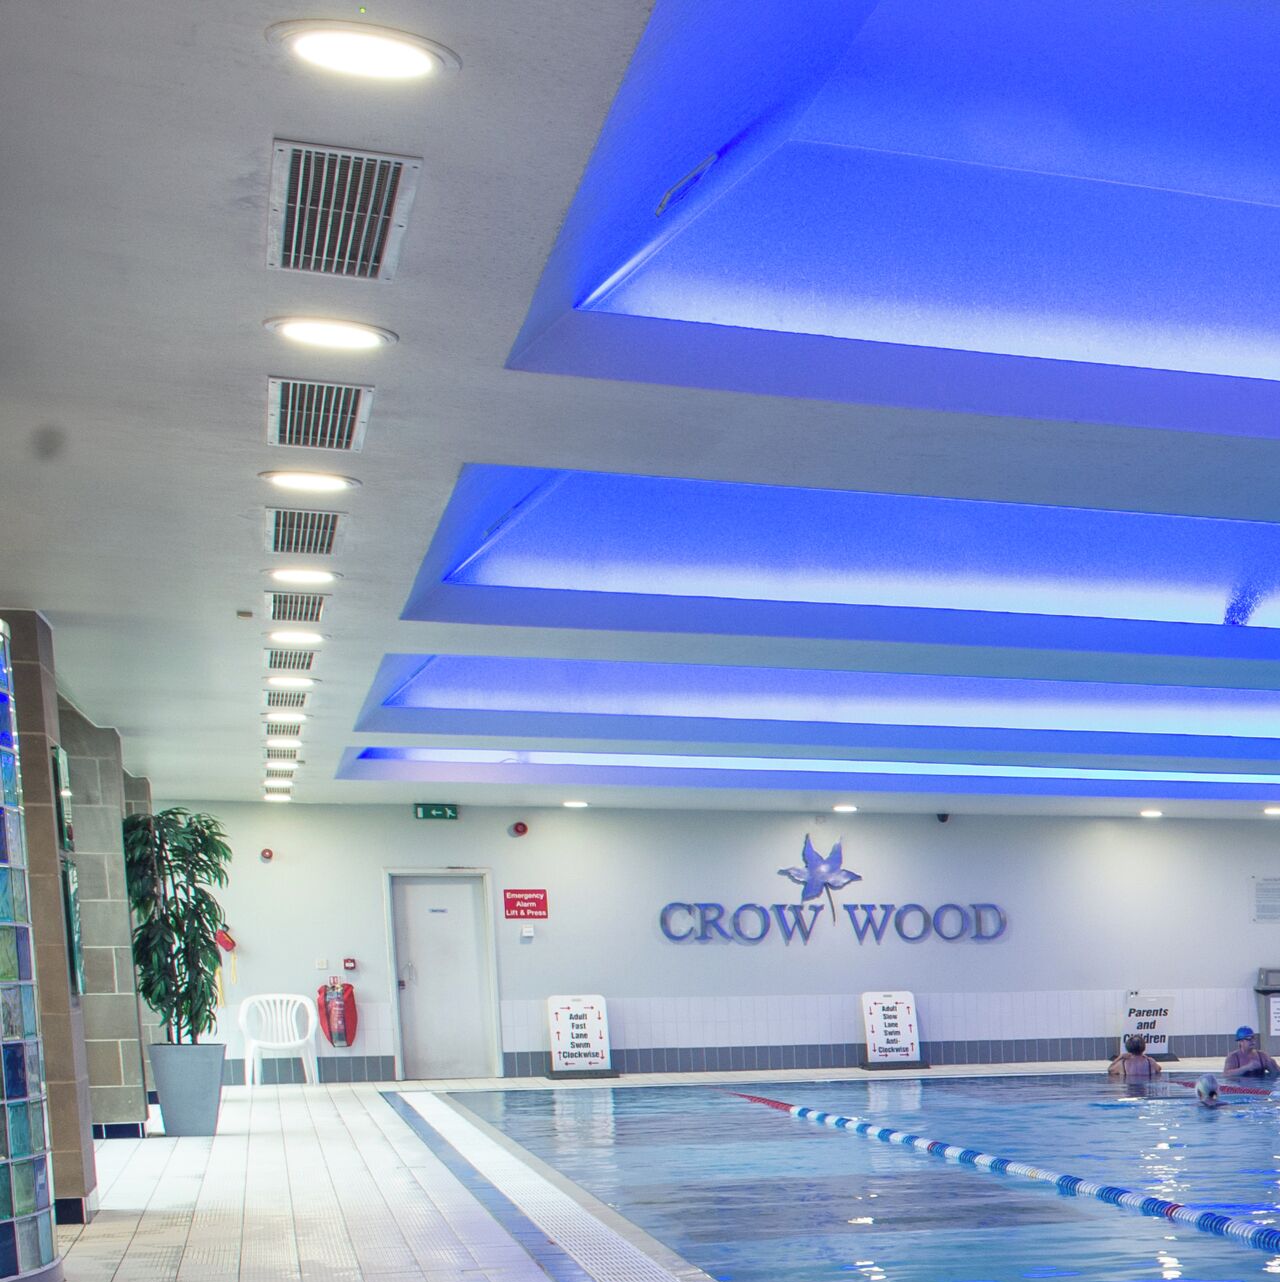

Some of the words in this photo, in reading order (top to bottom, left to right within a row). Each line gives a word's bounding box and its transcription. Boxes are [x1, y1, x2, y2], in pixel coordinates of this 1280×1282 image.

[506, 892, 544, 900] Emergency
[659, 902, 825, 945] CROW
[843, 903, 1008, 945] WOOD
[1128, 1008, 1168, 1017] Parents
[1136, 1020, 1156, 1030] and
[1123, 1033, 1166, 1043] Cdren
[562, 1051, 600, 1059] Clockwise
